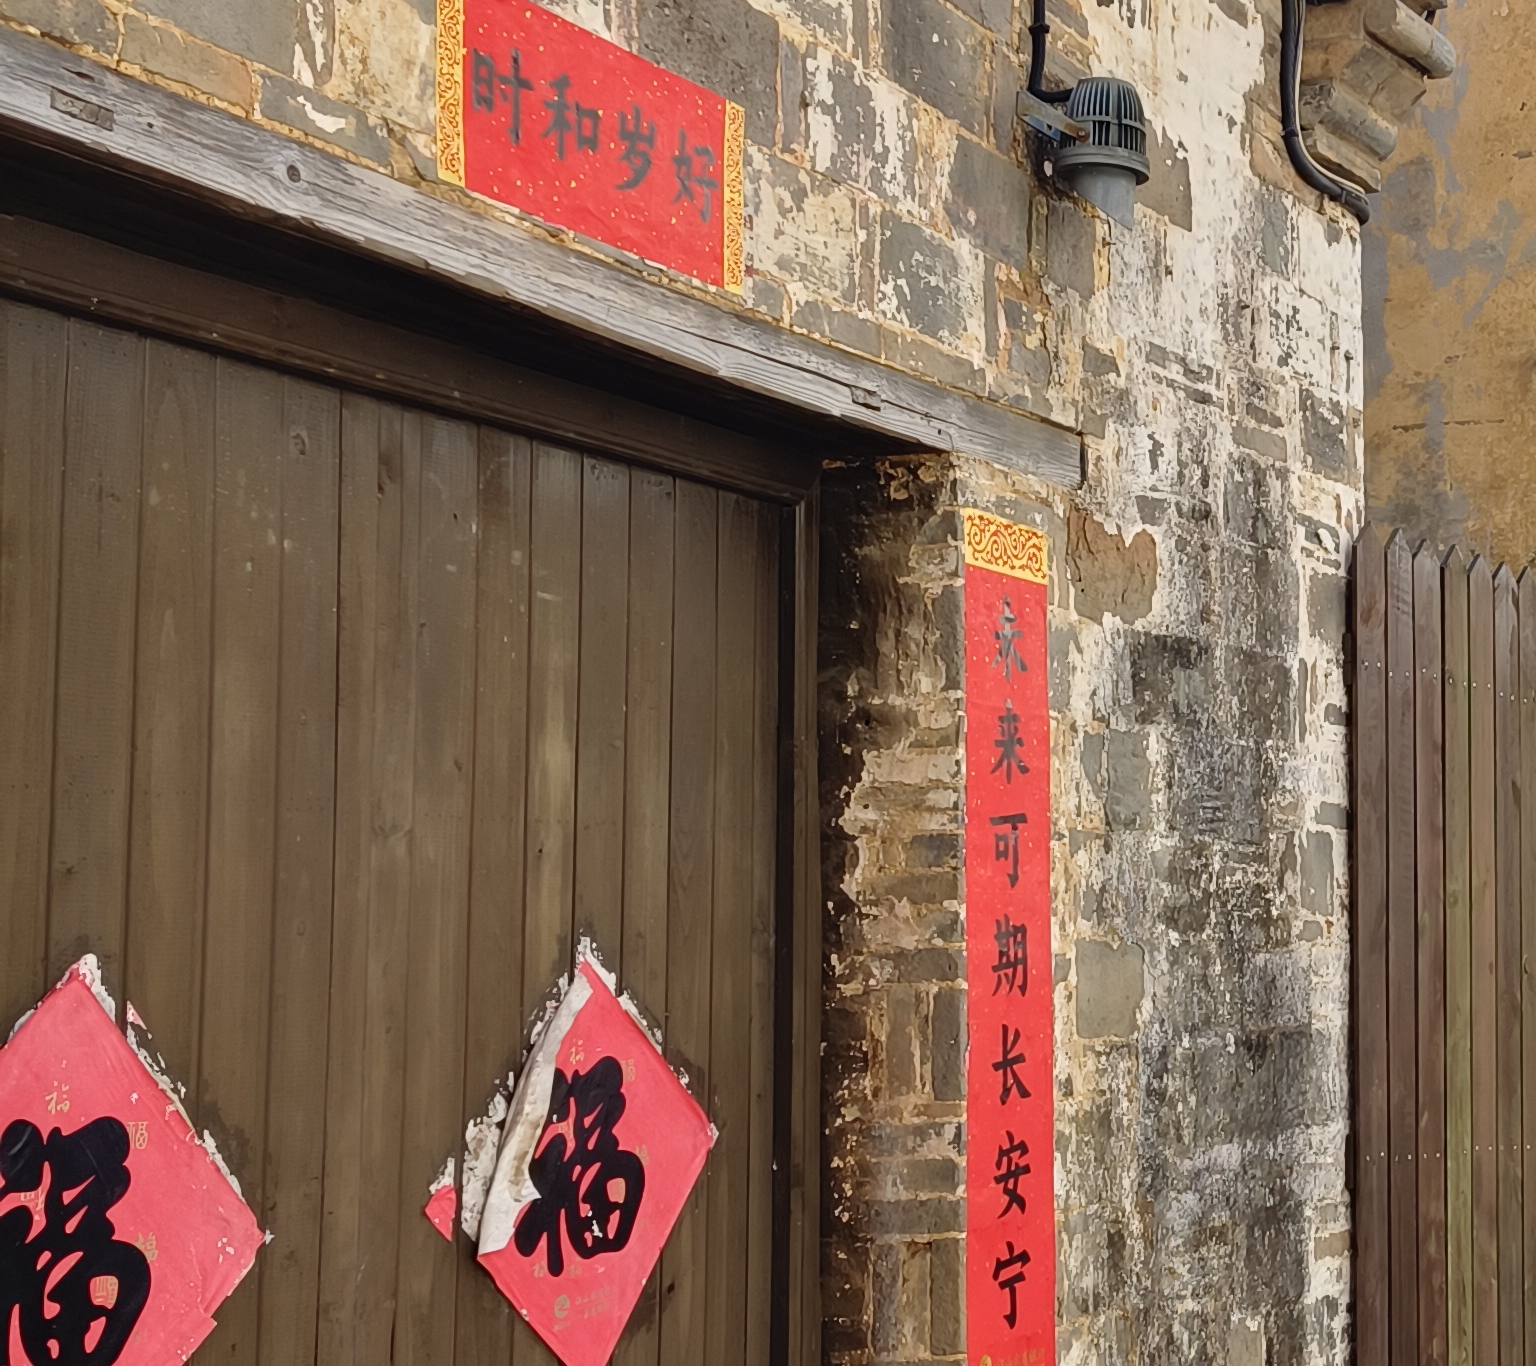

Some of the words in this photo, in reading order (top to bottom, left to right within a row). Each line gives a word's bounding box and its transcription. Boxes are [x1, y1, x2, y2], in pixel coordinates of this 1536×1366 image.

[471, 47, 719, 224] 时和岁好
[990, 595, 1032, 1329] 未来可期长安宁
[513, 1055, 646, 1277] 福
